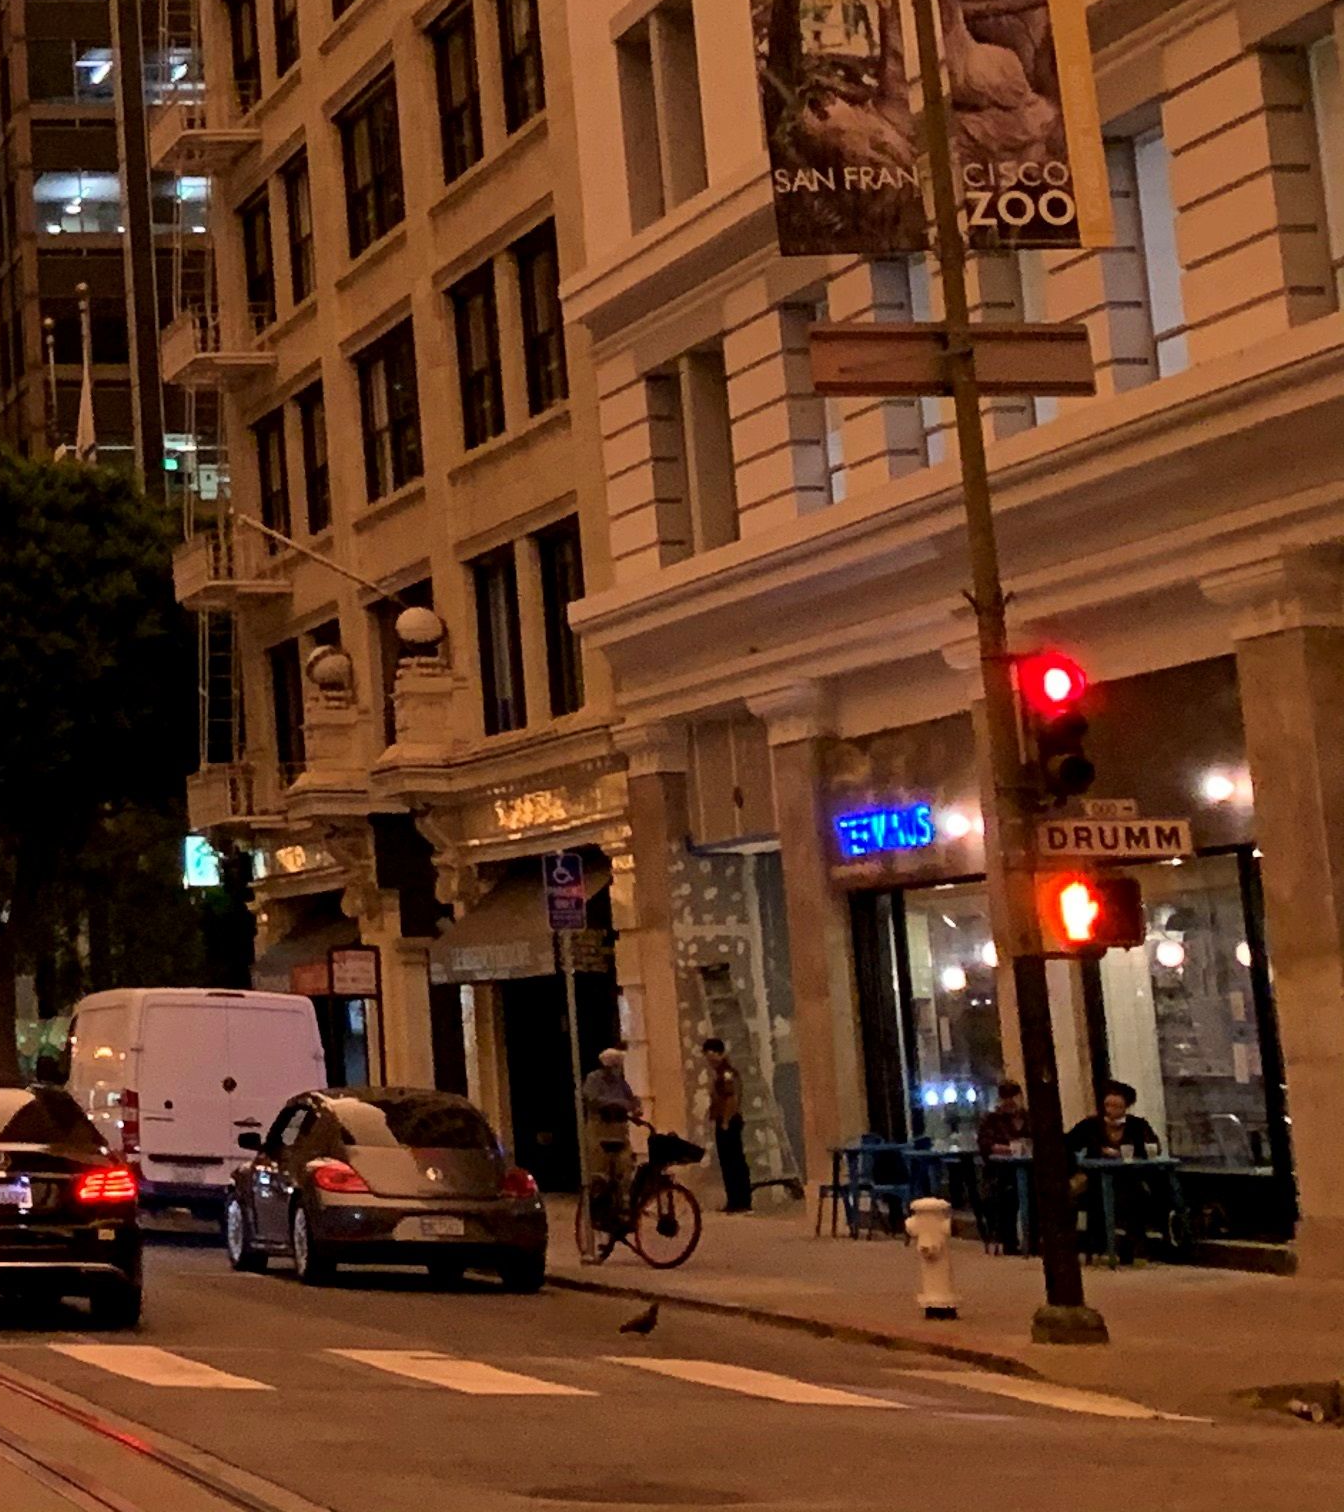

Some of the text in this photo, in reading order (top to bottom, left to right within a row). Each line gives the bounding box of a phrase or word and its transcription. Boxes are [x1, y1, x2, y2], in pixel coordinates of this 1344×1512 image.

[774, 165, 920, 194] SAN FRAN
[963, 162, 1068, 187] CISCO
[965, 189, 1076, 226] ZOO
[1047, 825, 1182, 851] DRUMM
